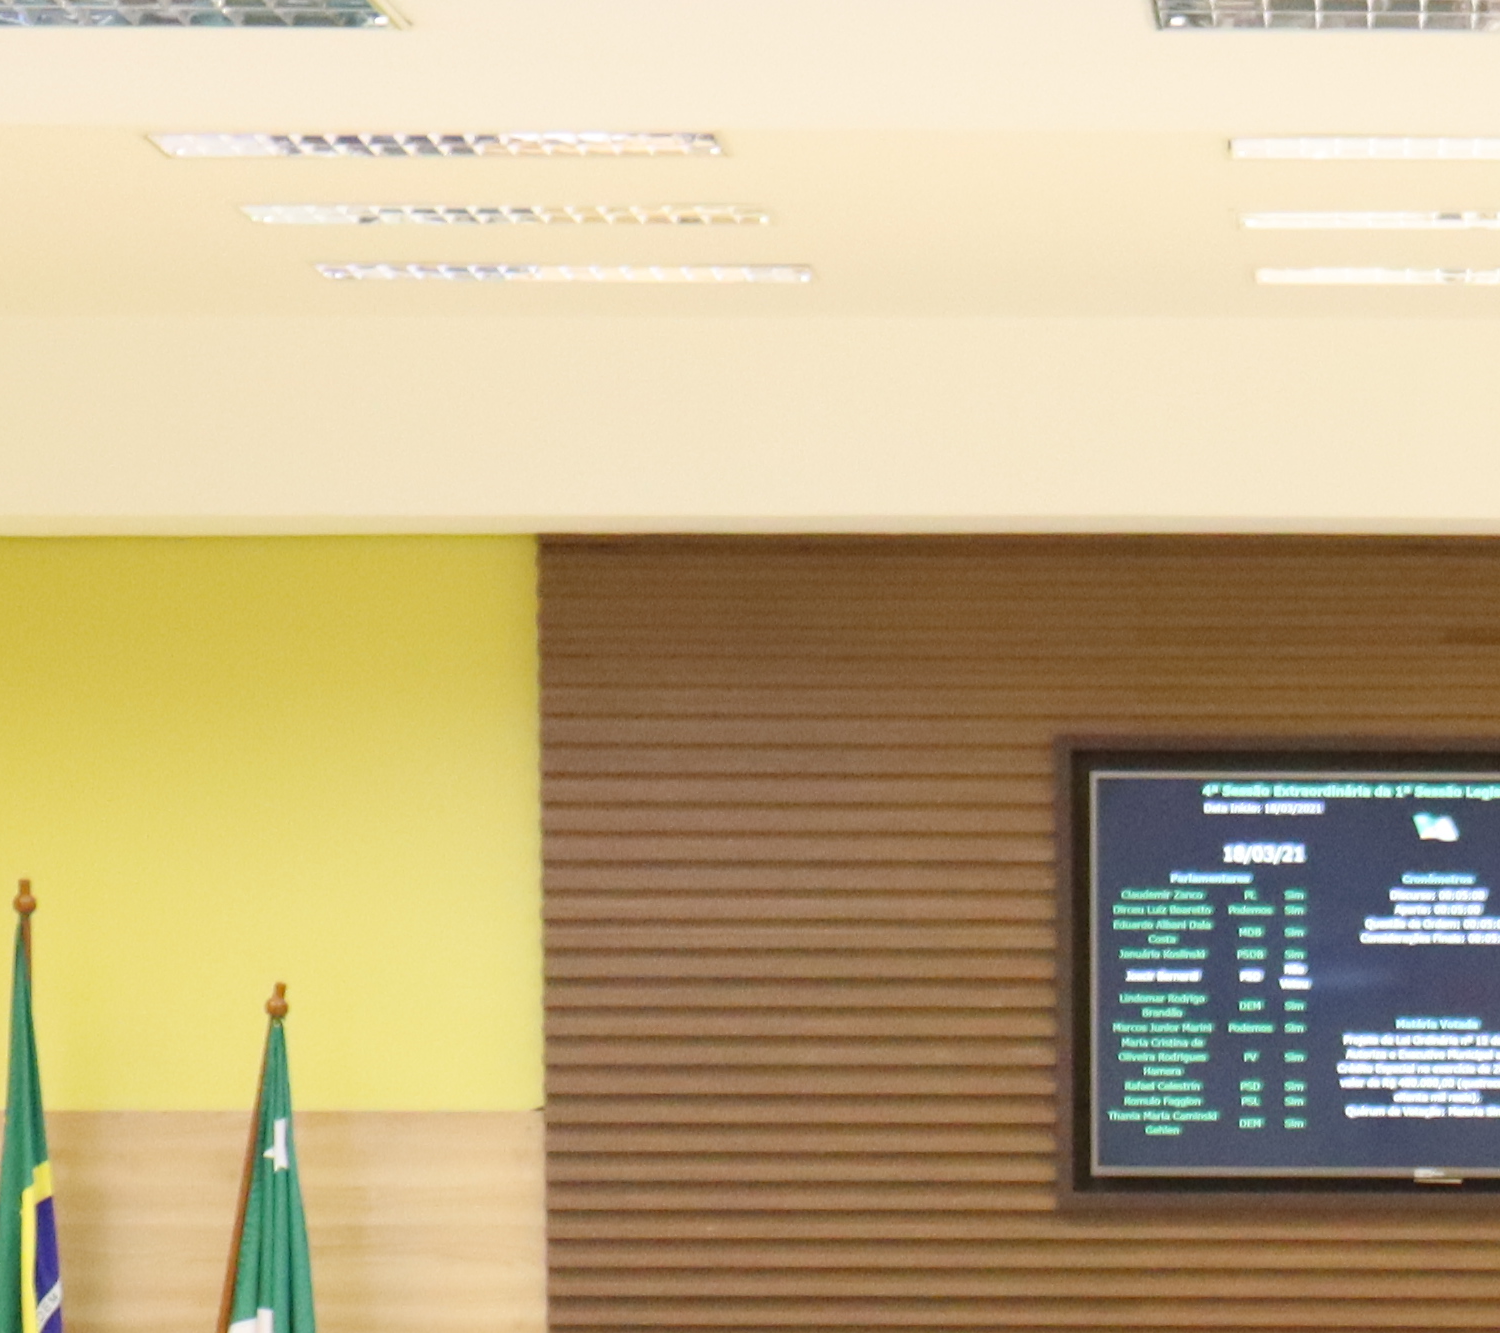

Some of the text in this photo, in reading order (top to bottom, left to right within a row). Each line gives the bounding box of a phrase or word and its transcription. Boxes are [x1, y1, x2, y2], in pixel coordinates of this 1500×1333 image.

[1202, 784, 1220, 797] 4ª
[1220, 784, 1272, 797] Sessão
[1273, 784, 1373, 798] Extraordinária
[1373, 785, 1394, 798] da
[1395, 785, 1413, 798] 1ª
[1413, 785, 1464, 798] Sessão
[1223, 843, 1306, 865] 18/03/21
